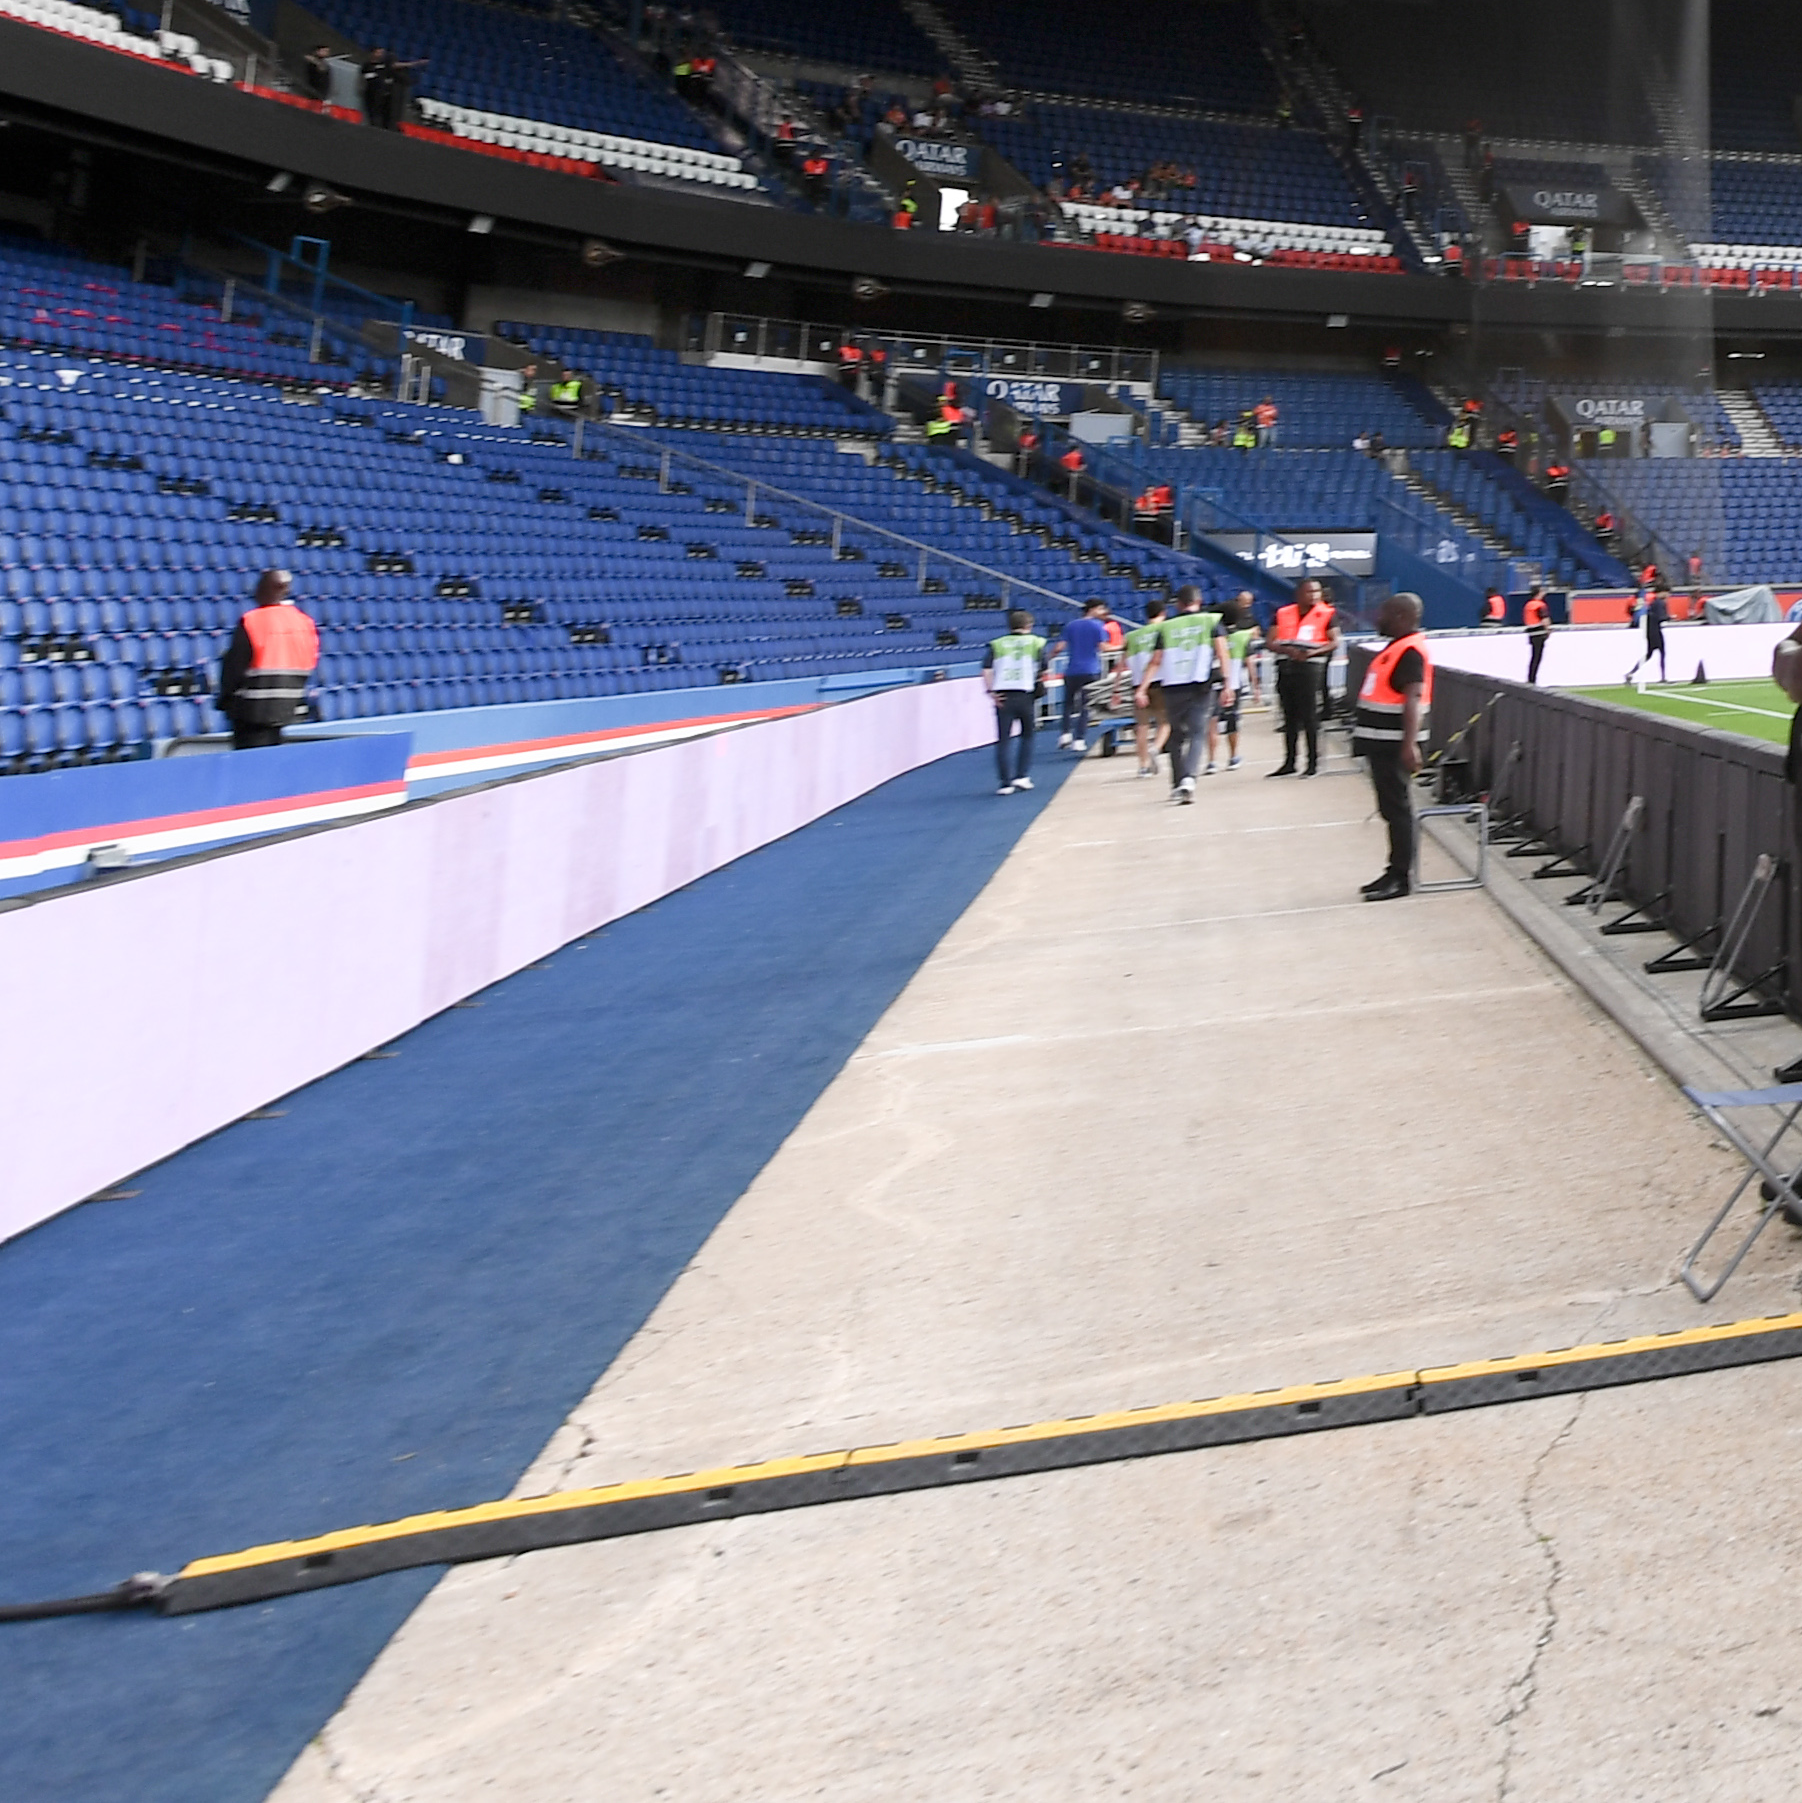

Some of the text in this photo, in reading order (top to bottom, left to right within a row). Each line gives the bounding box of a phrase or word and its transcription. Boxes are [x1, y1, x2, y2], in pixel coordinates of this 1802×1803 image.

[895, 139, 968, 165] QATAR
[1532, 191, 1598, 209] QATAR
[1576, 399, 1645, 419] QATAR
